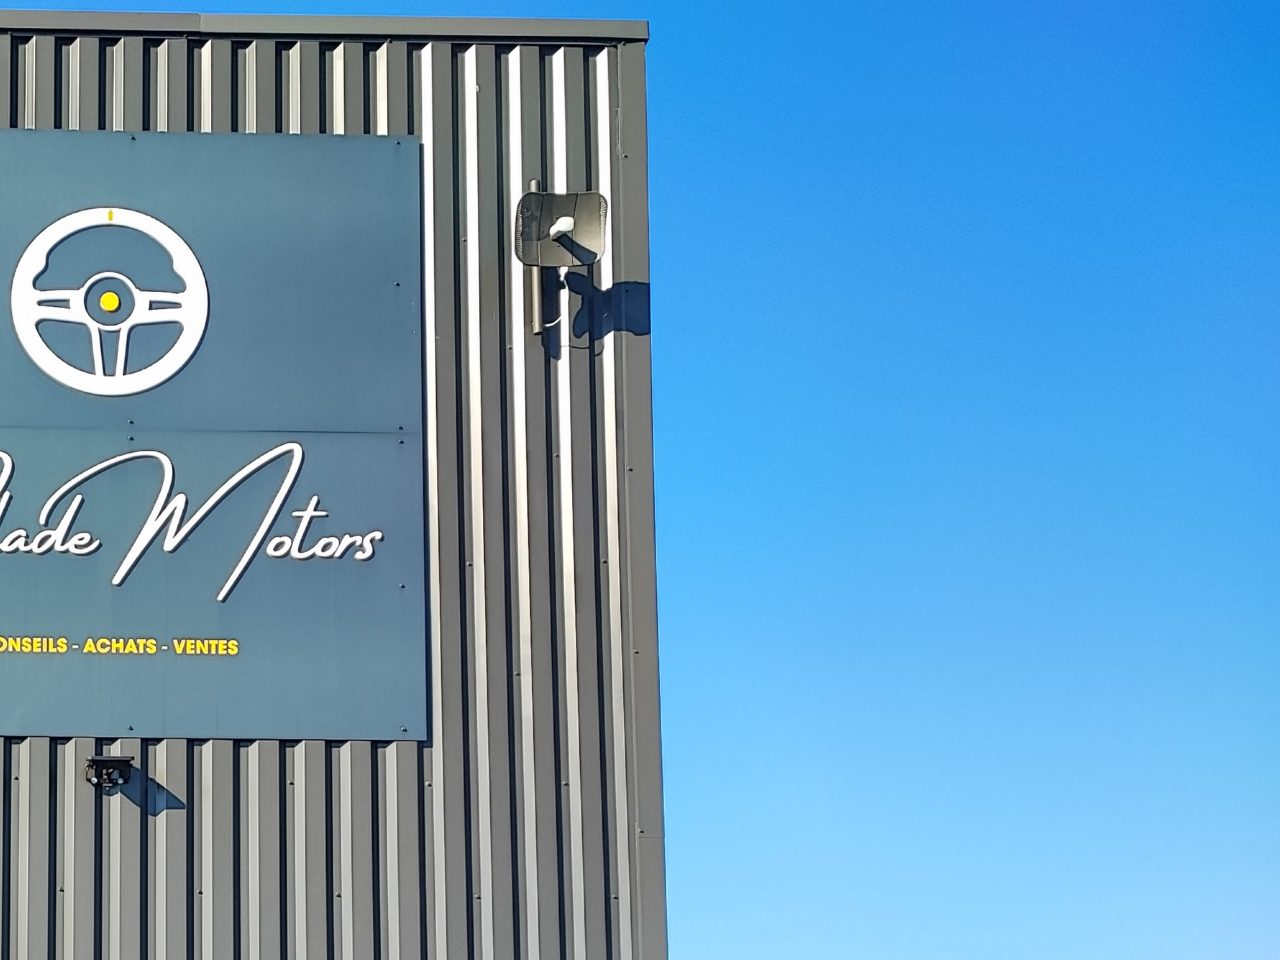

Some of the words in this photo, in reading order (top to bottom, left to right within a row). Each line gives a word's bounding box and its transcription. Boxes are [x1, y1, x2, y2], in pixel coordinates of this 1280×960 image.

[37, 441, 384, 602] Motors
[82, 636, 158, 656] ACHATS
[173, 638, 240, 657] VENTES
